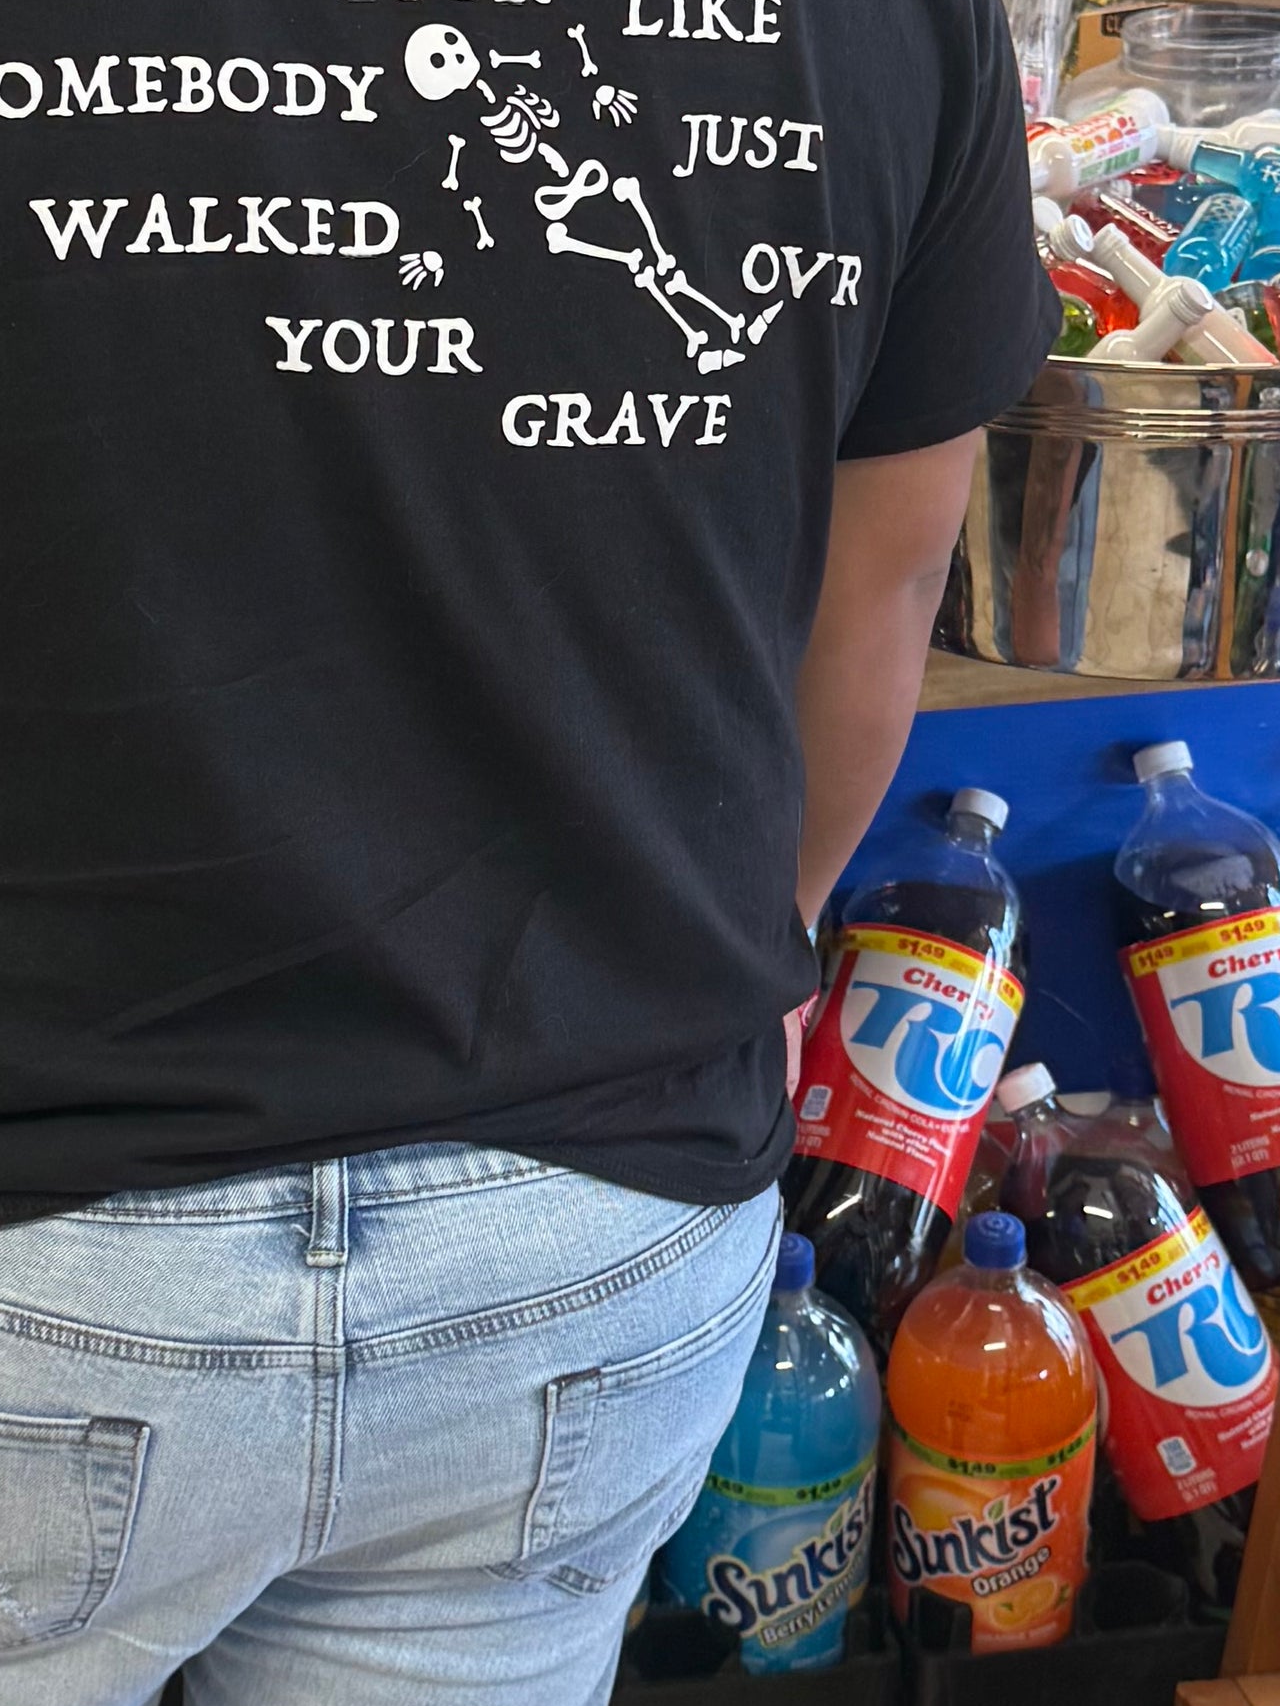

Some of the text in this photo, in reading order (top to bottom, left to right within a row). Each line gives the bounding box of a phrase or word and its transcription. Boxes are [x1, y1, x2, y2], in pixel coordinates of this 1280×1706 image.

[672, 114, 825, 178] JUST
[29, 196, 862, 307] WALKED OVR
[266, 315, 485, 376] YOUR
[501, 391, 732, 448] GRAVE
[896, 938, 946, 961] $1.49
[1138, 945, 1176, 969] $1.49
[1219, 918, 1267, 945] $1.49
[903, 966, 996, 1021] Cherry
[849, 980, 1006, 1114] RC
[1117, 1252, 1162, 1284] $1.49
[1145, 1250, 1223, 1307] Cherry
[947, 1459, 997, 1478] $1.49
[890, 1474, 1062, 1584] Sunkist
[971, 1545, 1052, 1597] Orange
[761, 1610, 821, 1647] Berry
